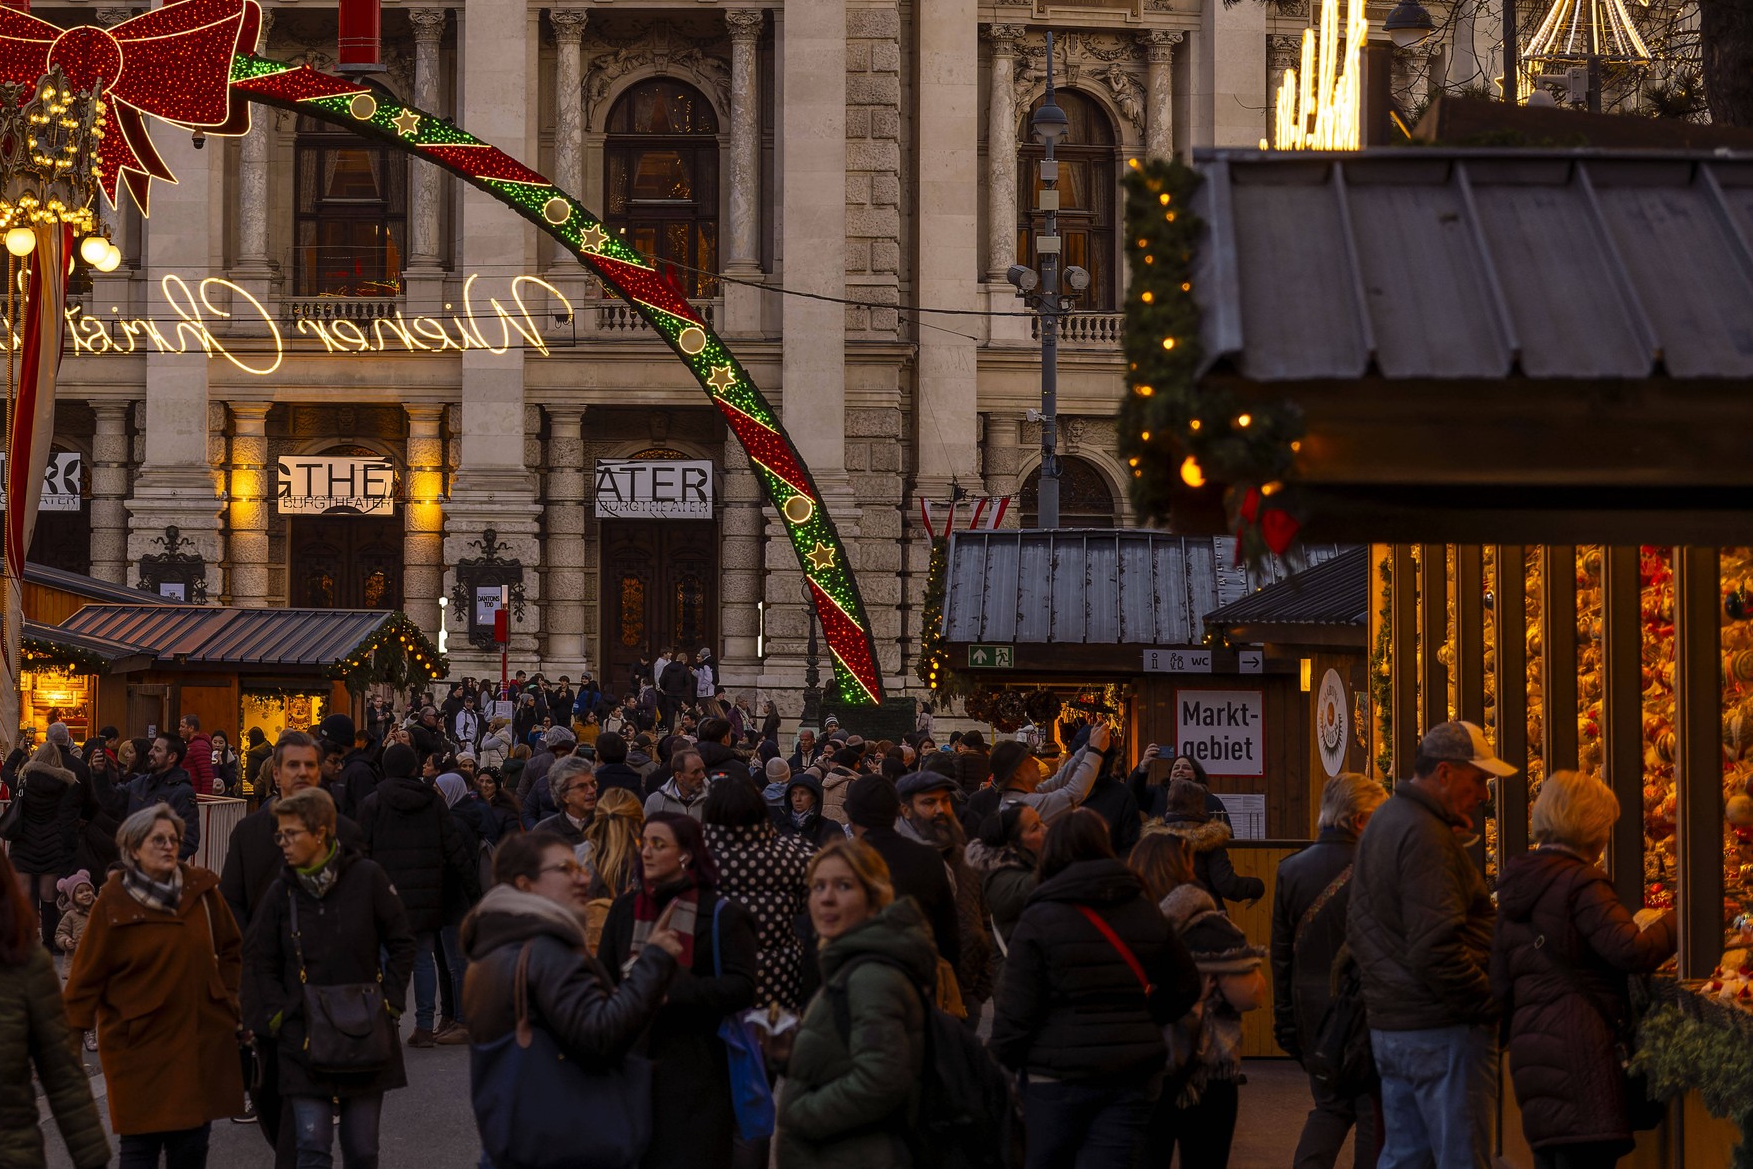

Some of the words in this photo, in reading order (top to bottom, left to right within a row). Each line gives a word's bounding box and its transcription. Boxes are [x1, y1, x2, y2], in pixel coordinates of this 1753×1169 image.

[596, 467, 708, 503] ATER
[1182, 700, 1259, 727] Markt-
[1182, 735, 1253, 761] gebiet
